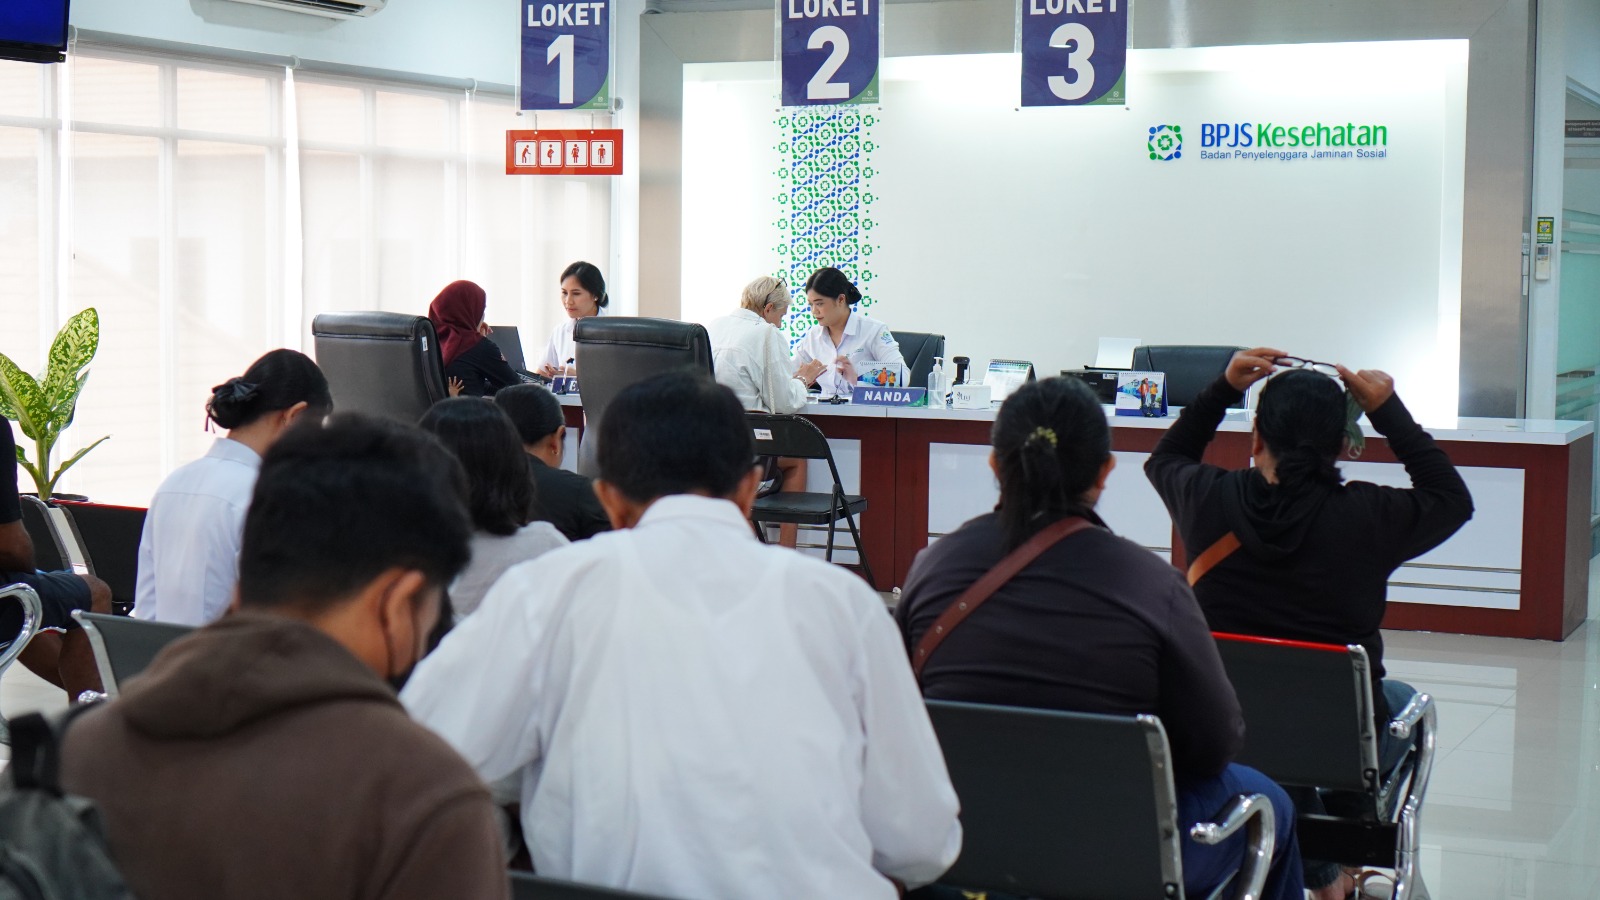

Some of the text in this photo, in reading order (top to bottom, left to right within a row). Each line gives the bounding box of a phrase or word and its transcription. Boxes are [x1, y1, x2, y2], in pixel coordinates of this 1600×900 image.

[527, 2, 605, 27] LOKET
[546, 34, 574, 104] 1
[806, 25, 850, 100] 2
[1047, 22, 1095, 101] 3
[1201, 122, 1387, 148] BPJS Kesehatan
[1200, 148, 1387, 161] Badan Penyelenggara Jaminan Sosial
[864, 390, 911, 402] NANDA
